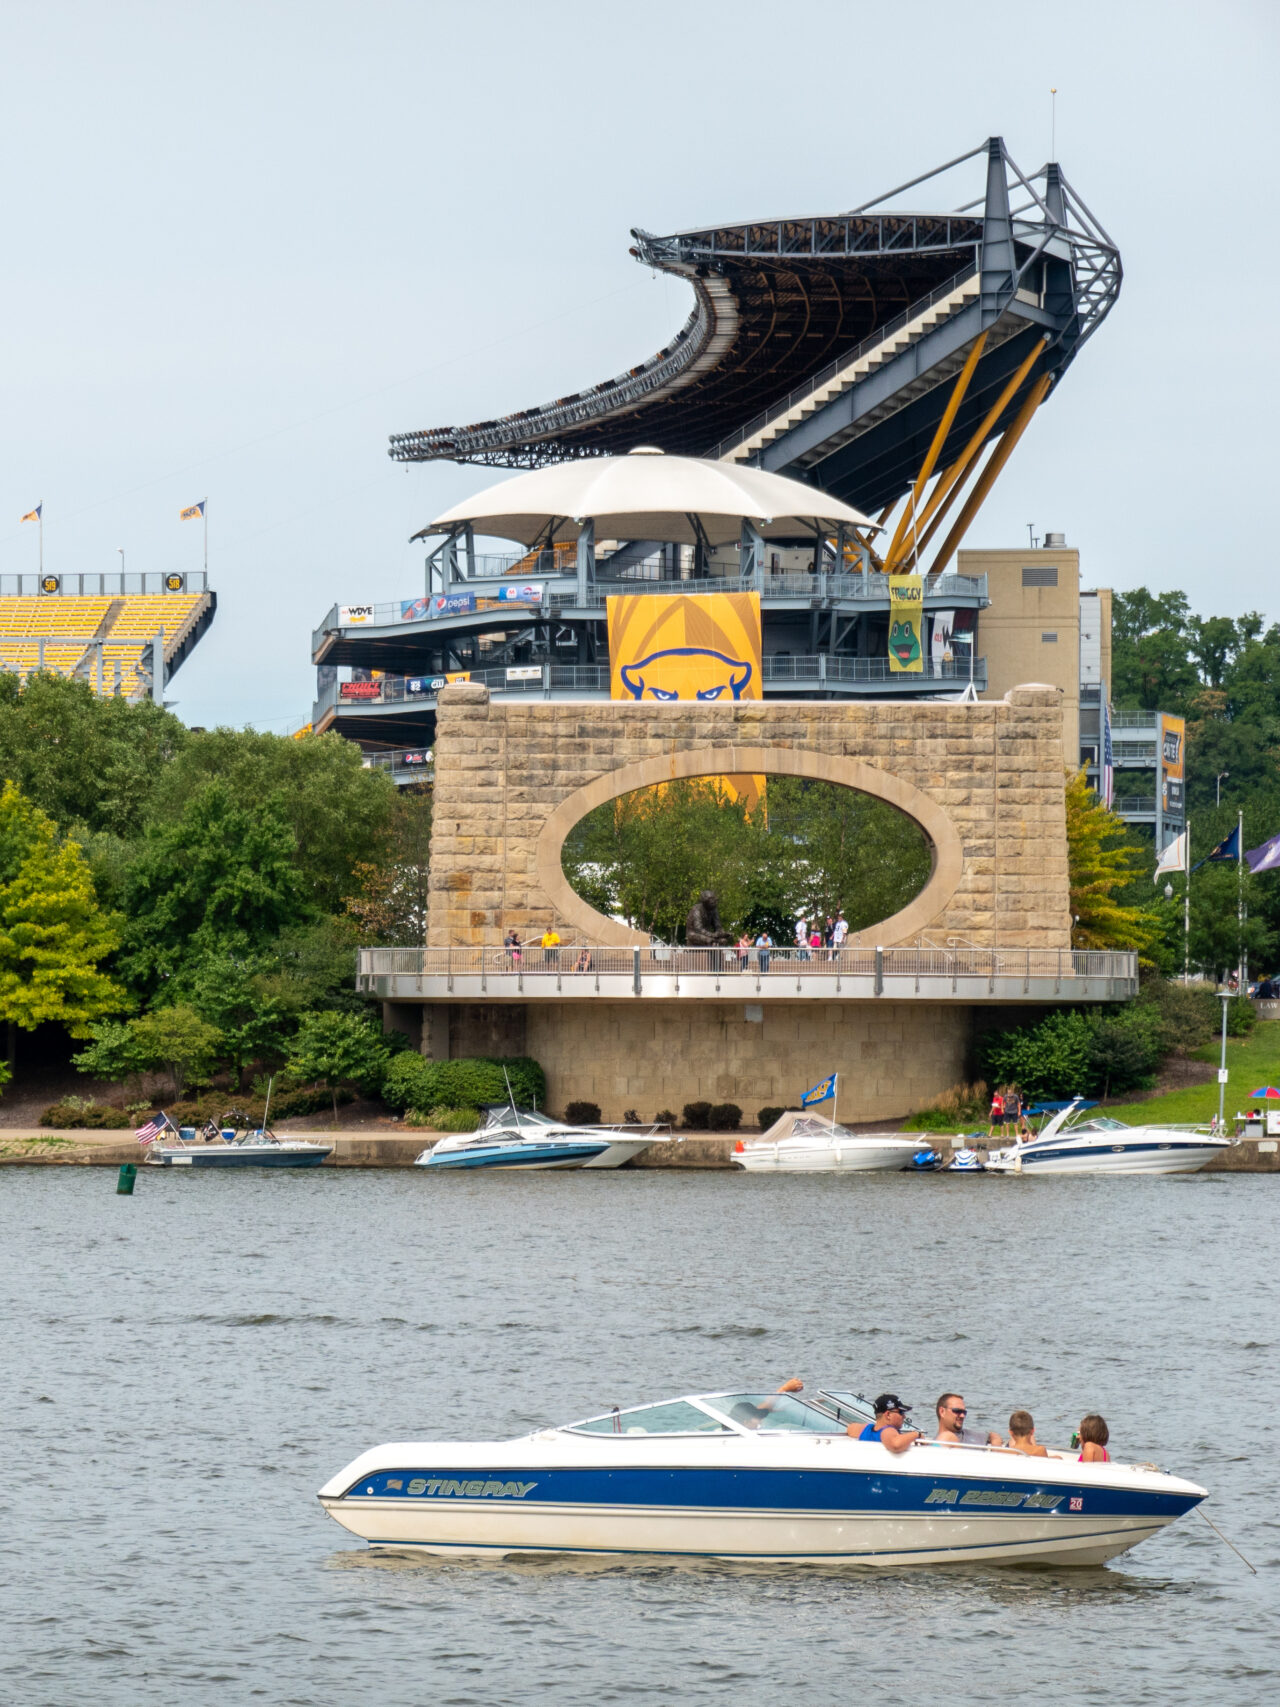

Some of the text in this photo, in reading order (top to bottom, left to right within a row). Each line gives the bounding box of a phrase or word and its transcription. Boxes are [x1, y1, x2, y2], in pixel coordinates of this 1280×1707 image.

[45, 580, 56, 591] 519
[168, 579, 180, 590] 518
[891, 587, 921, 601] FROGGY
[447, 595, 470, 608] pepsi
[349, 606, 373, 615] WDVE
[342, 681, 380, 690] CHOICE
[407, 1479, 539, 1498] STINGRAY
[924, 1488, 960, 1504] PA
[1071, 1499, 1083, 1509] 20
